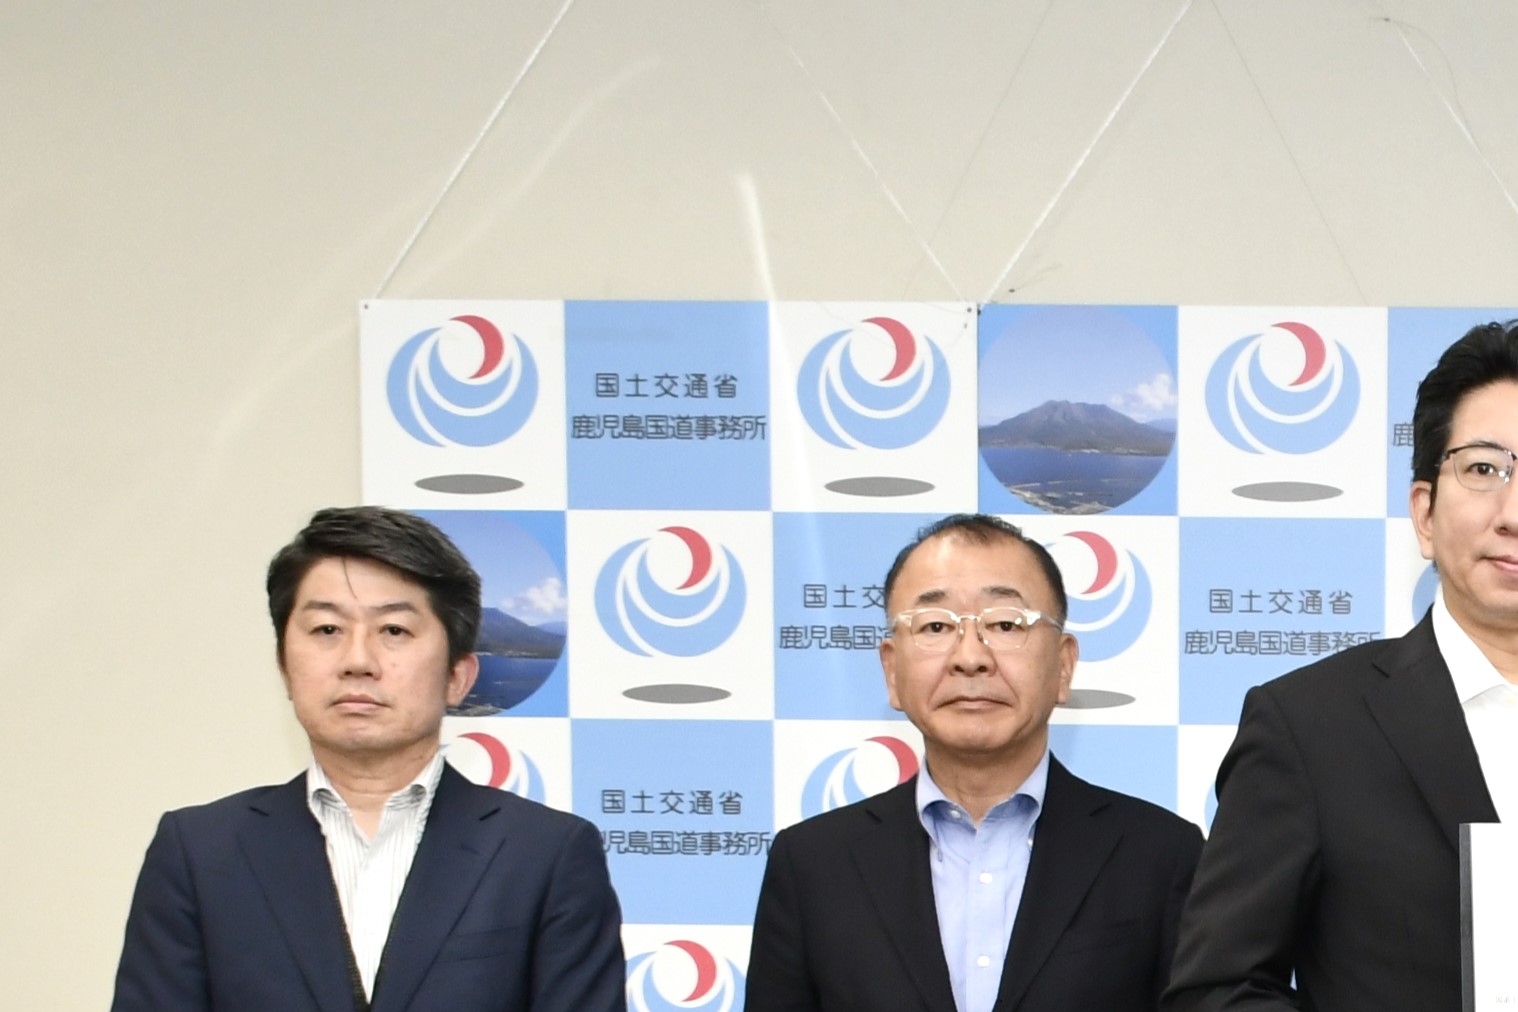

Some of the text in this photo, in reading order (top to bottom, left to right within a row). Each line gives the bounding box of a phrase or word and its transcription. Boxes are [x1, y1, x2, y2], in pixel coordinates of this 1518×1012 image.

[595, 372, 738, 399] 国土交通省
[571, 414, 767, 441] 鹿児島国道事務所
[803, 584, 886, 609] 国土交
[1209, 588, 1354, 615] 国土交通省
[780, 624, 892, 650] 鹿児島国
[601, 789, 744, 815] 国土交通省
[602, 830, 771, 856] 児島国道事務所
